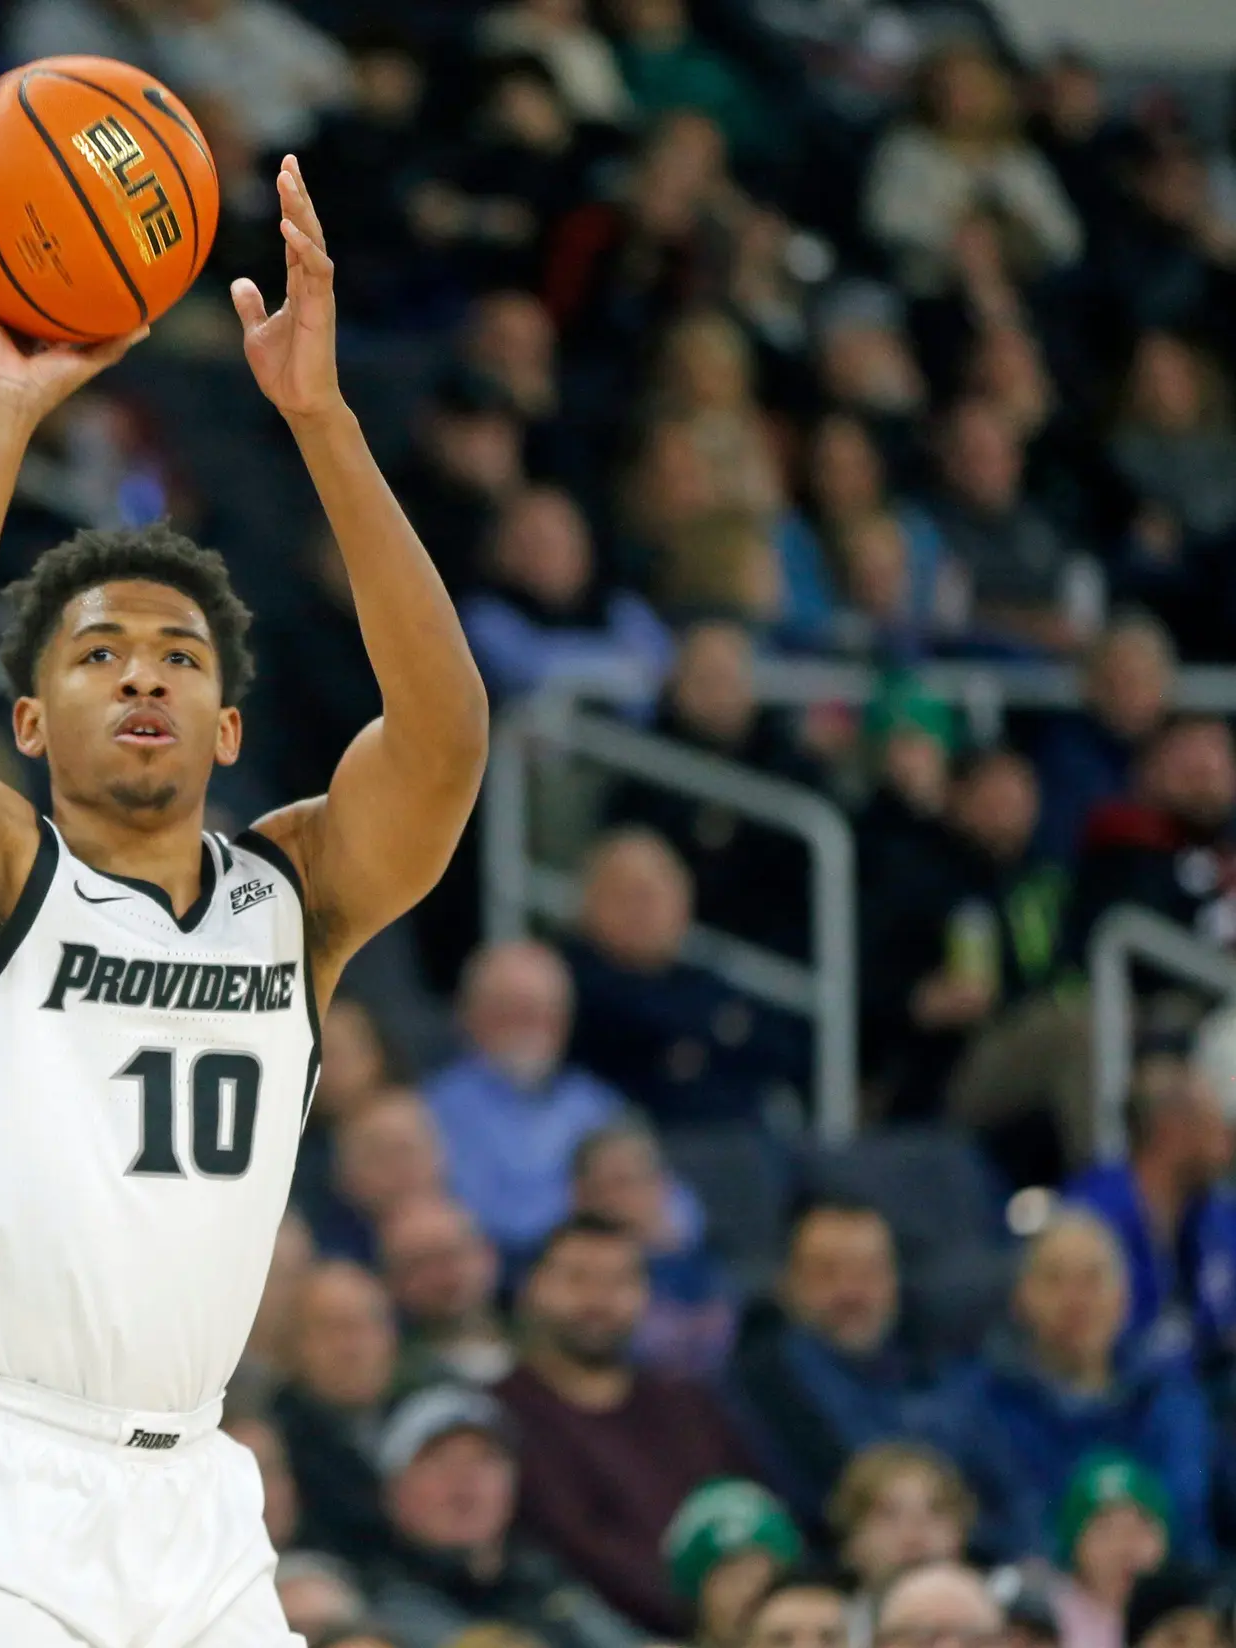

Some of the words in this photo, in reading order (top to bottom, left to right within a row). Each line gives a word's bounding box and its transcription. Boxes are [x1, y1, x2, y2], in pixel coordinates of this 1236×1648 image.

[81, 113, 183, 260] ELITE
[230, 879, 261, 900] BIG
[231, 883, 275, 910] EAST
[38, 940, 298, 1012] PROVIDENCE
[109, 1045, 264, 1181] 10
[125, 1428, 181, 1450] FRIARS
